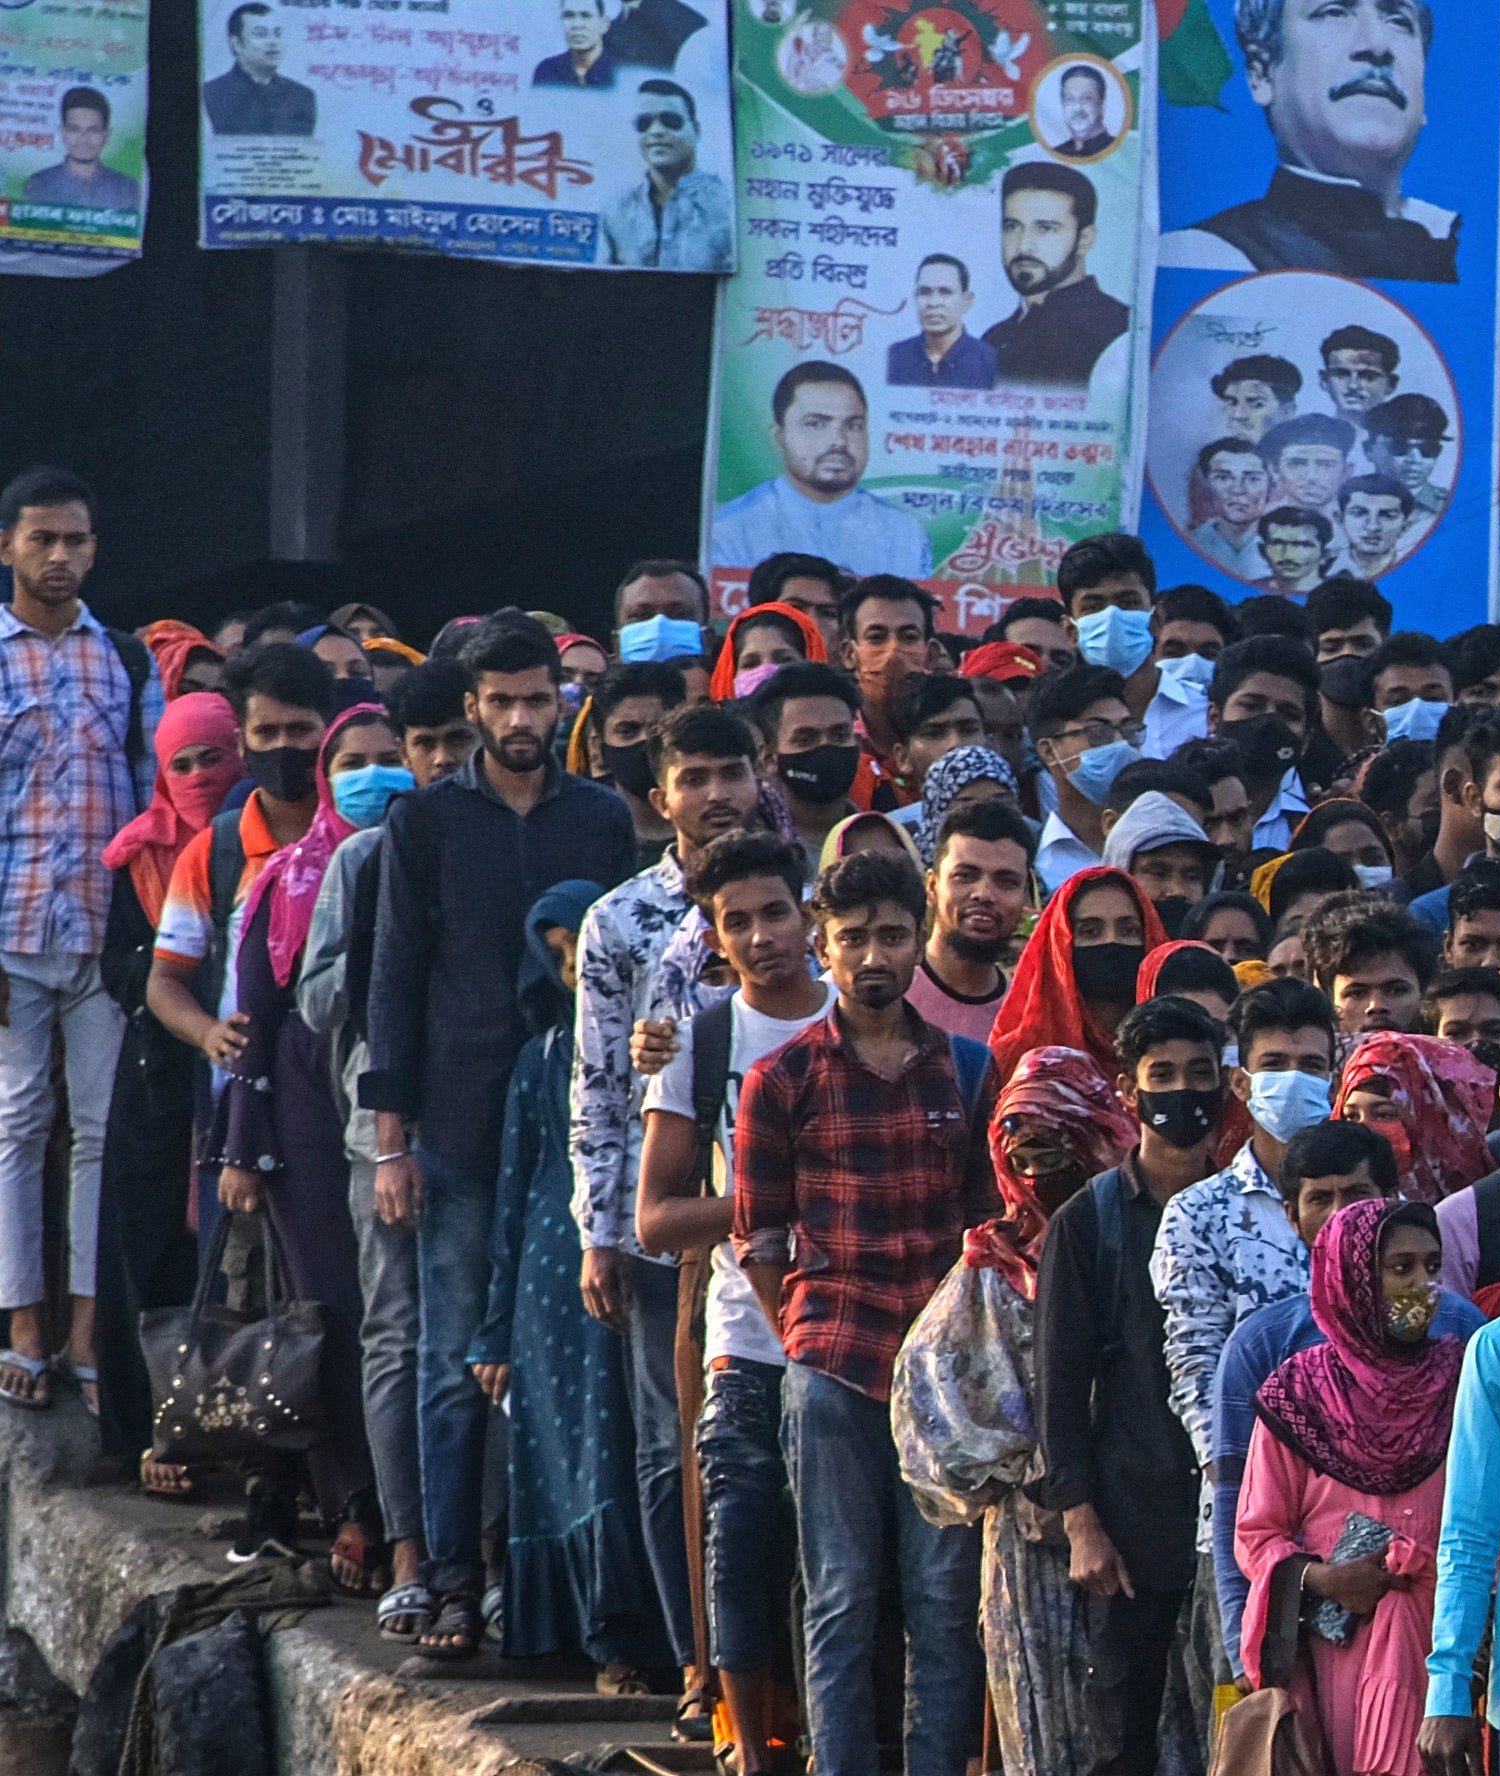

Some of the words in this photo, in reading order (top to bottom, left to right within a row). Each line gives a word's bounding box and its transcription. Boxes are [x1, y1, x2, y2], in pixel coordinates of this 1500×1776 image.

[751, 140, 812, 163] ১৯৭১
[821, 144, 888, 167] সালের
[746, 178, 800, 200] মহান
[465, 211, 541, 236] হোসেন
[747, 218, 800, 241] সকল
[765, 251, 805, 280] প্রতি
